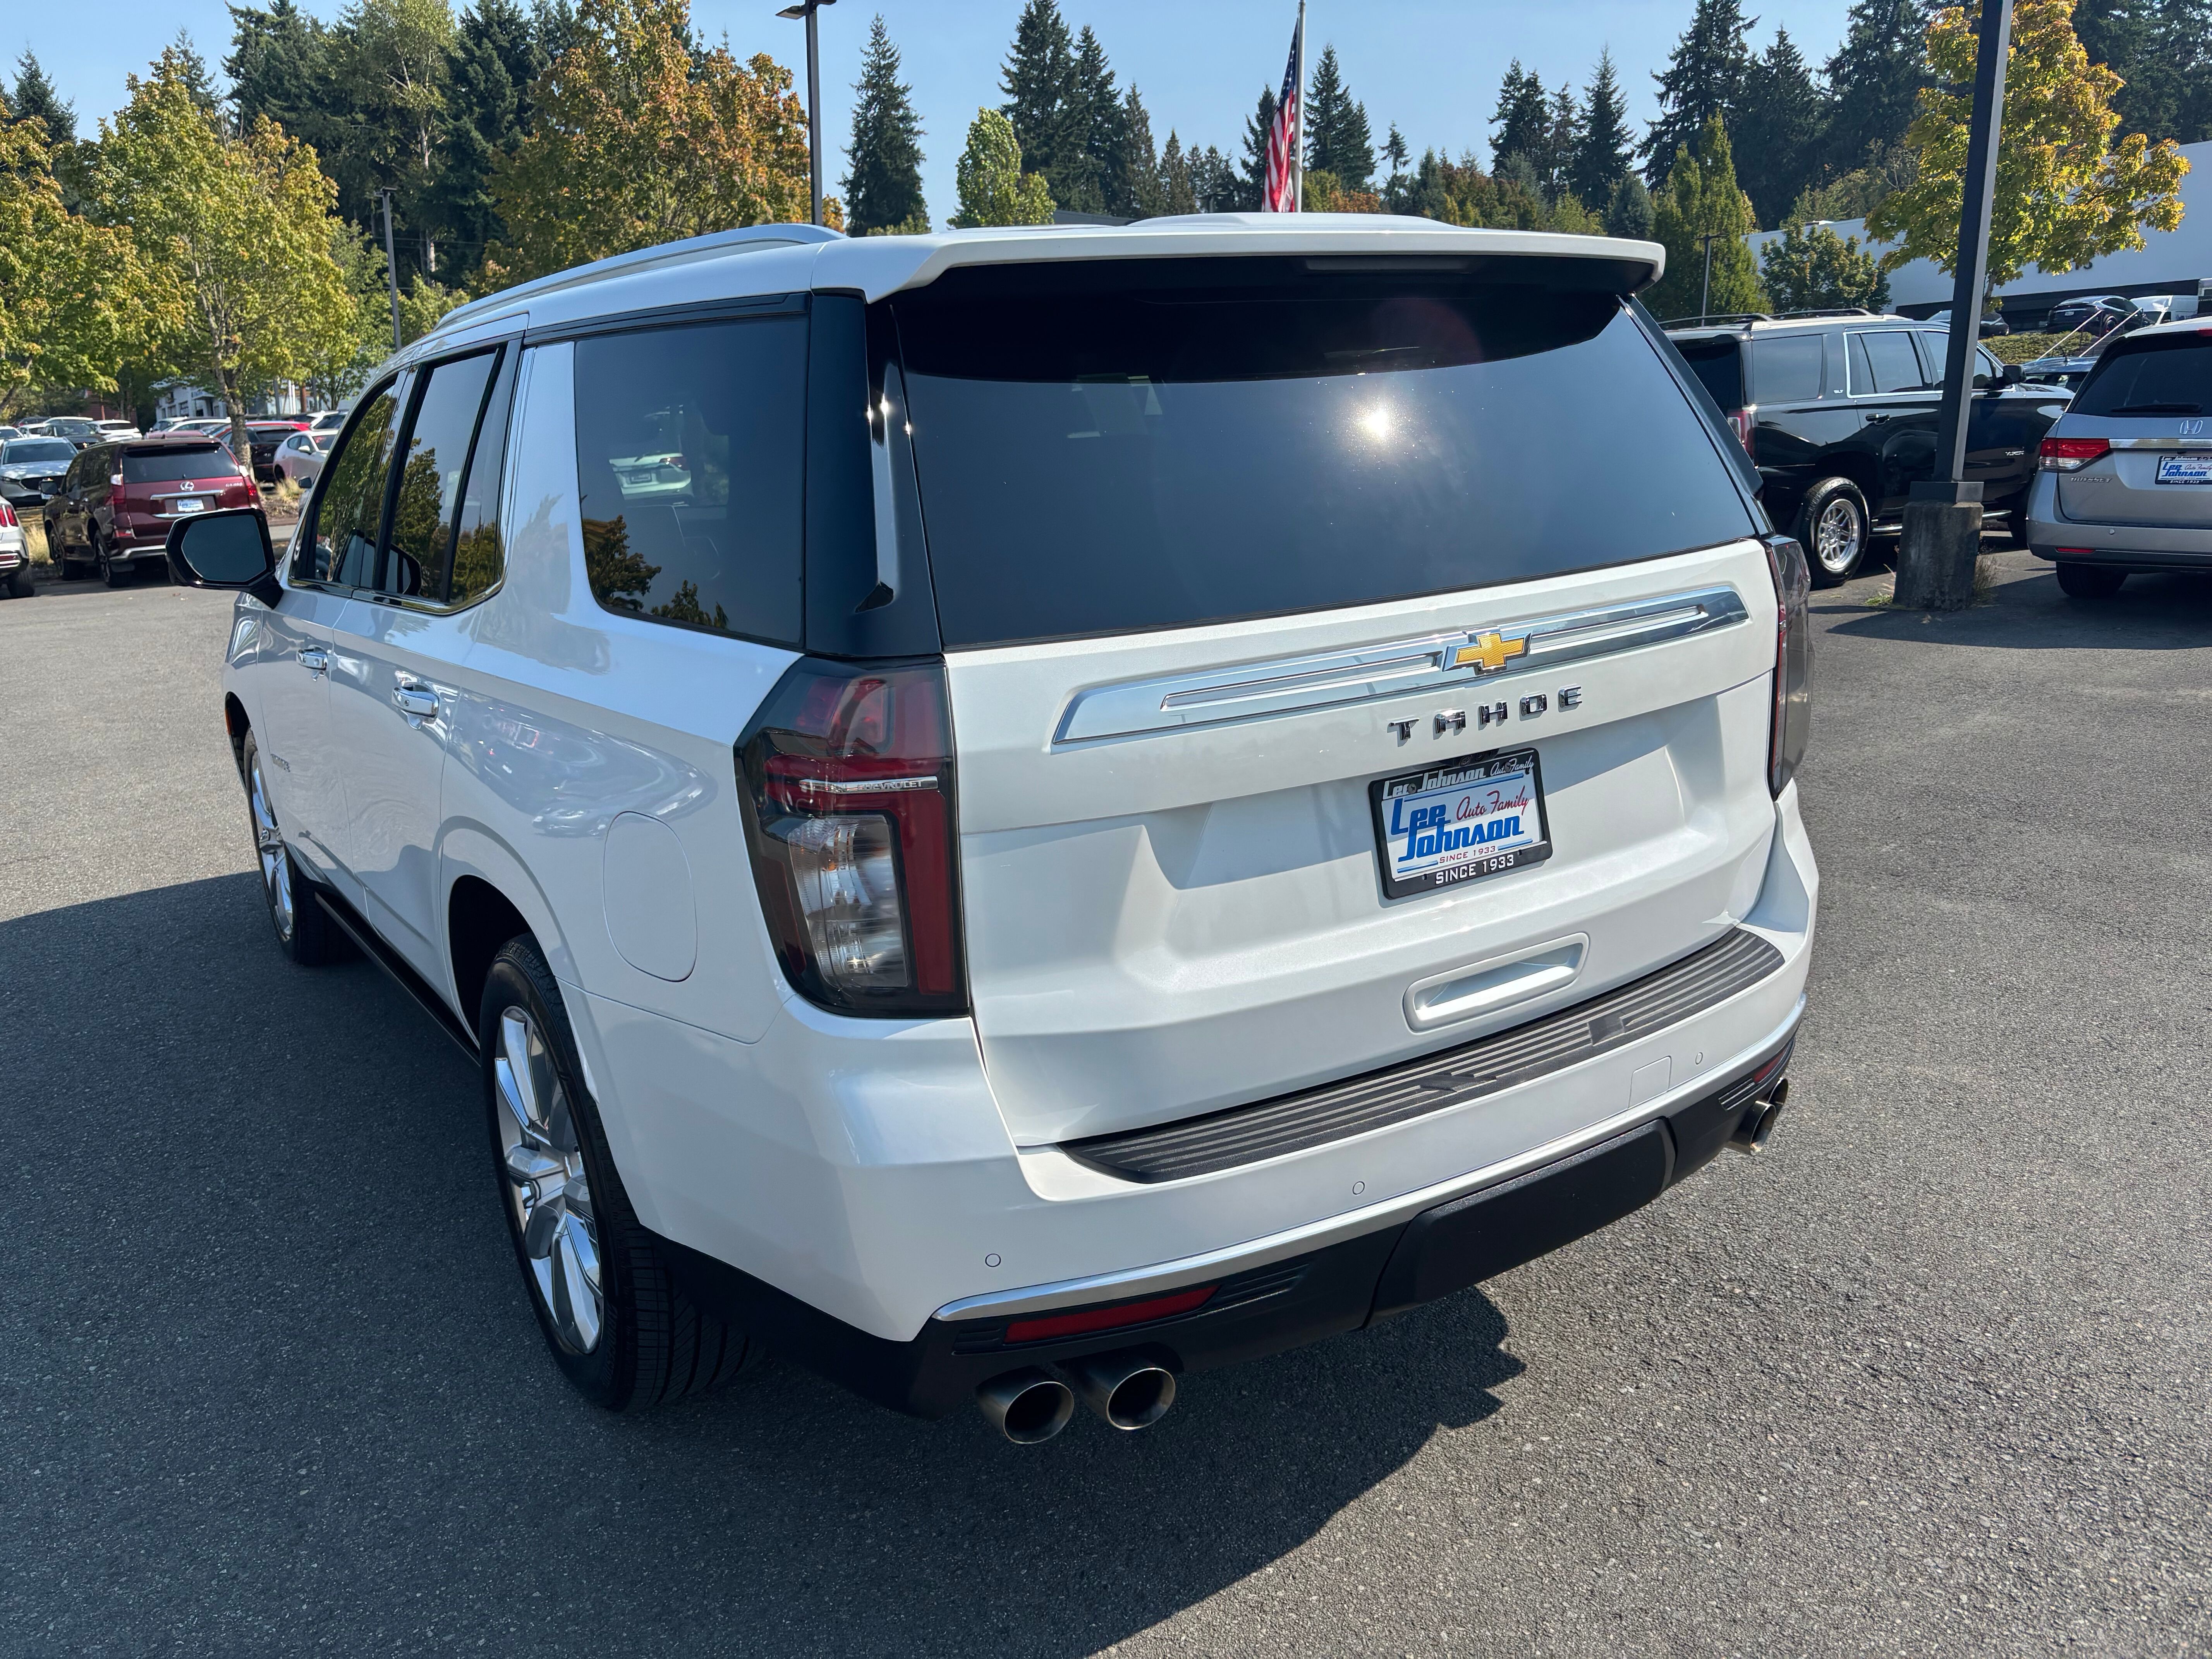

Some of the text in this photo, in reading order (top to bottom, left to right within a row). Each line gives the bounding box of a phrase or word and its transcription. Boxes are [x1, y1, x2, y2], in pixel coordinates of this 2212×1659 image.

[2162, 462, 2183, 470] Lee
[1389, 685, 1582, 740] TAHOE
[1417, 768, 1486, 792] Johnson
[1490, 762, 1507, 776] Aut
[1509, 755, 1534, 773] Family
[1391, 798, 1447, 835] Lee
[1456, 785, 1529, 821] Auto Family
[1398, 816, 1525, 862] Johnson
[1439, 846, 1496, 863] SINCE 1933
[1435, 854, 1514, 884] SINCE 1933
